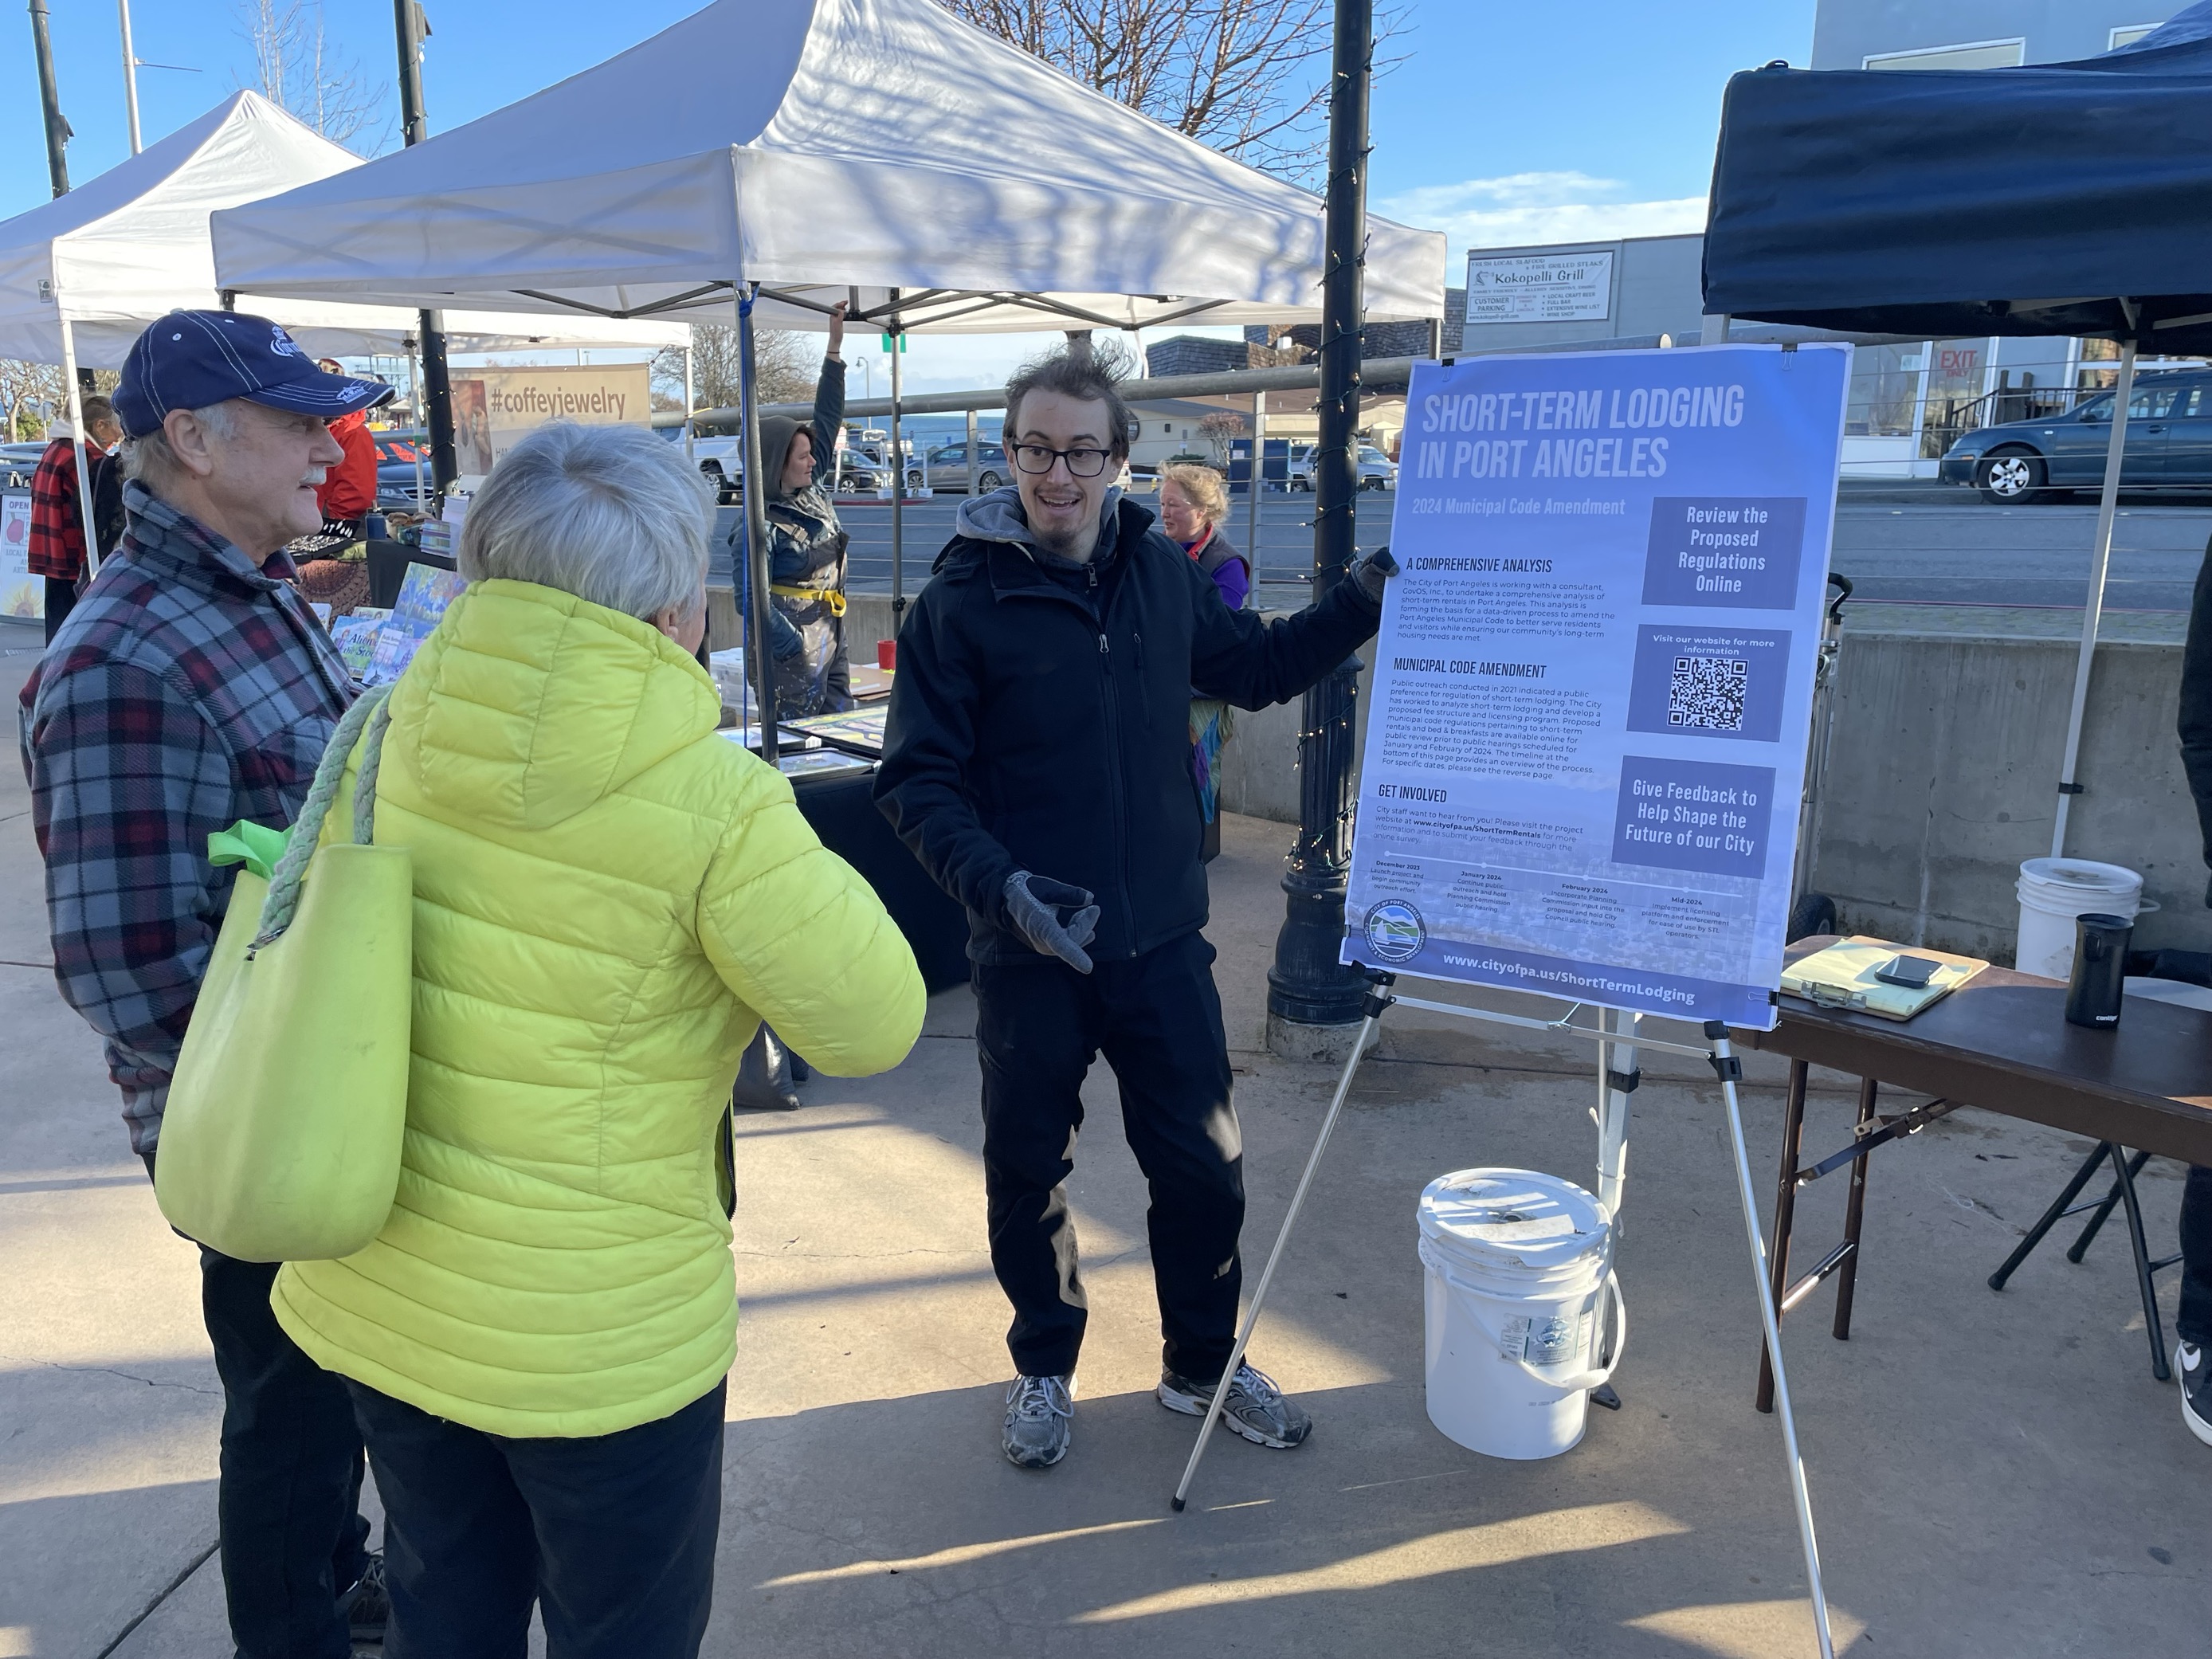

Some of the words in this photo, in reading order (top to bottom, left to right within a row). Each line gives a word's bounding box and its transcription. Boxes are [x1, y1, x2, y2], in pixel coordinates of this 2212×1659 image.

[1496, 271, 1551, 284] Kokopelli
[1558, 269, 1583, 280] Grill
[1940, 350, 1977, 368] EXIT
[492, 386, 626, 420] #coffeyjewelry
[1422, 390, 1603, 433] SHORT-TERM
[1610, 385, 1745, 429] LODGING
[1418, 441, 1447, 478] IN
[1453, 440, 1528, 478] PORT
[1532, 437, 1669, 477] ANGELES
[1412, 498, 1441, 515] 2024
[1445, 498, 1505, 517] Municipal
[1510, 498, 1540, 514] Code
[1544, 498, 1626, 515] Amendment
[1687, 507, 1739, 523] Review
[1743, 507, 1767, 524] the
[1691, 529, 1759, 549] Proposed
[1406, 558, 1413, 570] A
[1416, 557, 1500, 571] COMPREHENSIVE
[1502, 559, 1553, 573] ANALYSIS
[1678, 551, 1766, 571] Regulations
[1418, 579, 1432, 589] City
[1460, 580, 1490, 590] Angeles
[1500, 582, 1531, 591] working
[1559, 583, 1603, 592] consultant,
[1696, 575, 1742, 592] Online
[1401, 596, 1440, 605] short-term
[1495, 599, 1527, 609] Angeles.
[1547, 601, 1579, 610] analysis
[1403, 587, 1427, 596] GovOS,
[1502, 590, 1561, 599] comprehensive
[1563, 592, 1594, 602] analysis
[1401, 605, 1428, 615] forming
[1483, 607, 1527, 616] data-driven
[349, 633, 373, 646] Alien
[1694, 637, 1731, 645] website
[1684, 645, 1739, 655] information
[1394, 658, 1447, 673] MUNICIPAL
[1450, 661, 1476, 674] CODE
[1479, 662, 1547, 678] AMENDMENT
[1379, 784, 1398, 797] GET
[1399, 786, 1447, 803] INVOLVED
[1634, 779, 1662, 797] Give
[1668, 782, 1737, 805] Feedback
[1743, 790, 1757, 806] to
[1377, 805, 1390, 815] City
[1438, 811, 1455, 820] hear
[1457, 814, 1475, 822] from
[1495, 818, 1520, 826] Please
[1638, 802, 1669, 823] Help
[1673, 806, 1717, 827] Shape
[1722, 811, 1747, 829] the
[1375, 815, 1402, 824] website
[1414, 820, 1541, 838] www.cityofpa.us/ShortTermRentals
[1373, 832, 1394, 841] online
[1397, 836, 1421, 845] survey.
[1374, 822, 1415, 833] information
[1442, 831, 1468, 840] submit
[1488, 835, 1523, 845] feedback
[1525, 839, 1556, 851] through
[1626, 824, 1672, 844] Future
[1677, 830, 1692, 846] of
[1696, 835, 1721, 849] our
[1725, 834, 1755, 856] City
[1461, 871, 1485, 880] January
[1562, 884, 1590, 893] February
[1672, 896, 1703, 905] Mid-2024
[1371, 904, 1380, 913] CITY
[1404, 903, 1420, 920] ANGELES
[1364, 923, 1375, 951] COMMUNITY
[1379, 954, 1405, 963] ECONOMIC
[1407, 931, 1425, 959] DEVELOPMENT
[1444, 954, 1696, 1006] www.cityofpa.us/ShortTermLodging
